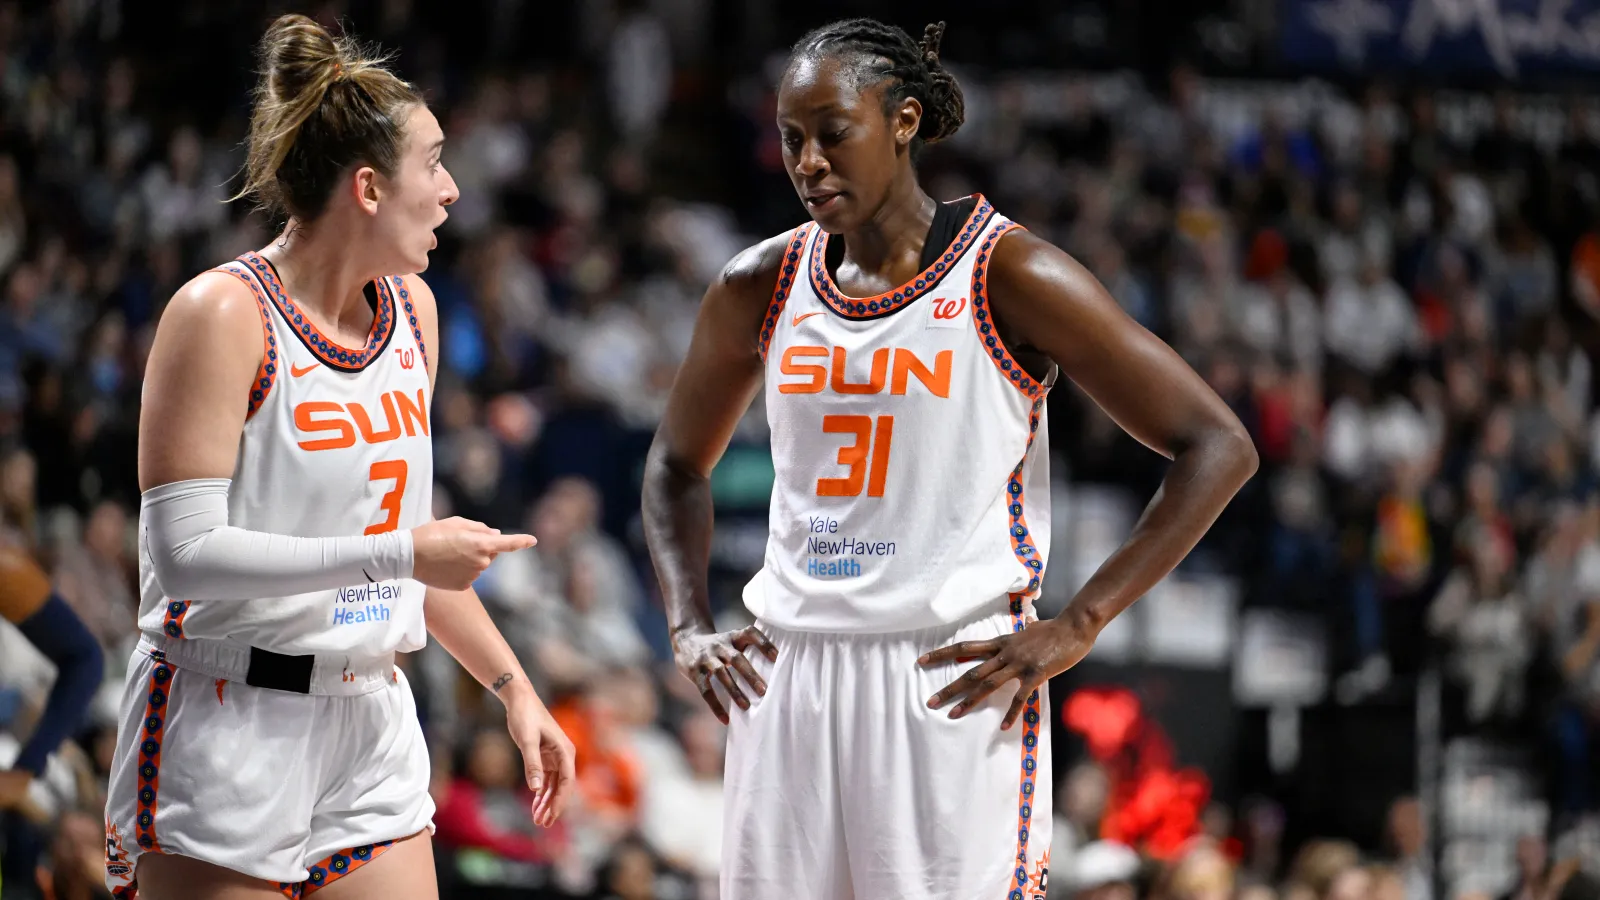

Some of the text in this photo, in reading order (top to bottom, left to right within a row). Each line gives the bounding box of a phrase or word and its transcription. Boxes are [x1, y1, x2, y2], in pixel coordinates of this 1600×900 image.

[777, 346, 954, 398] SUN
[293, 388, 429, 452] SUN
[816, 415, 895, 498] 31
[363, 459, 409, 537] 3
[809, 516, 838, 533] Yale
[807, 536, 896, 555] NewHaven
[808, 558, 861, 577] Health
[335, 583, 402, 604] NewHav
[333, 604, 390, 625] Health
